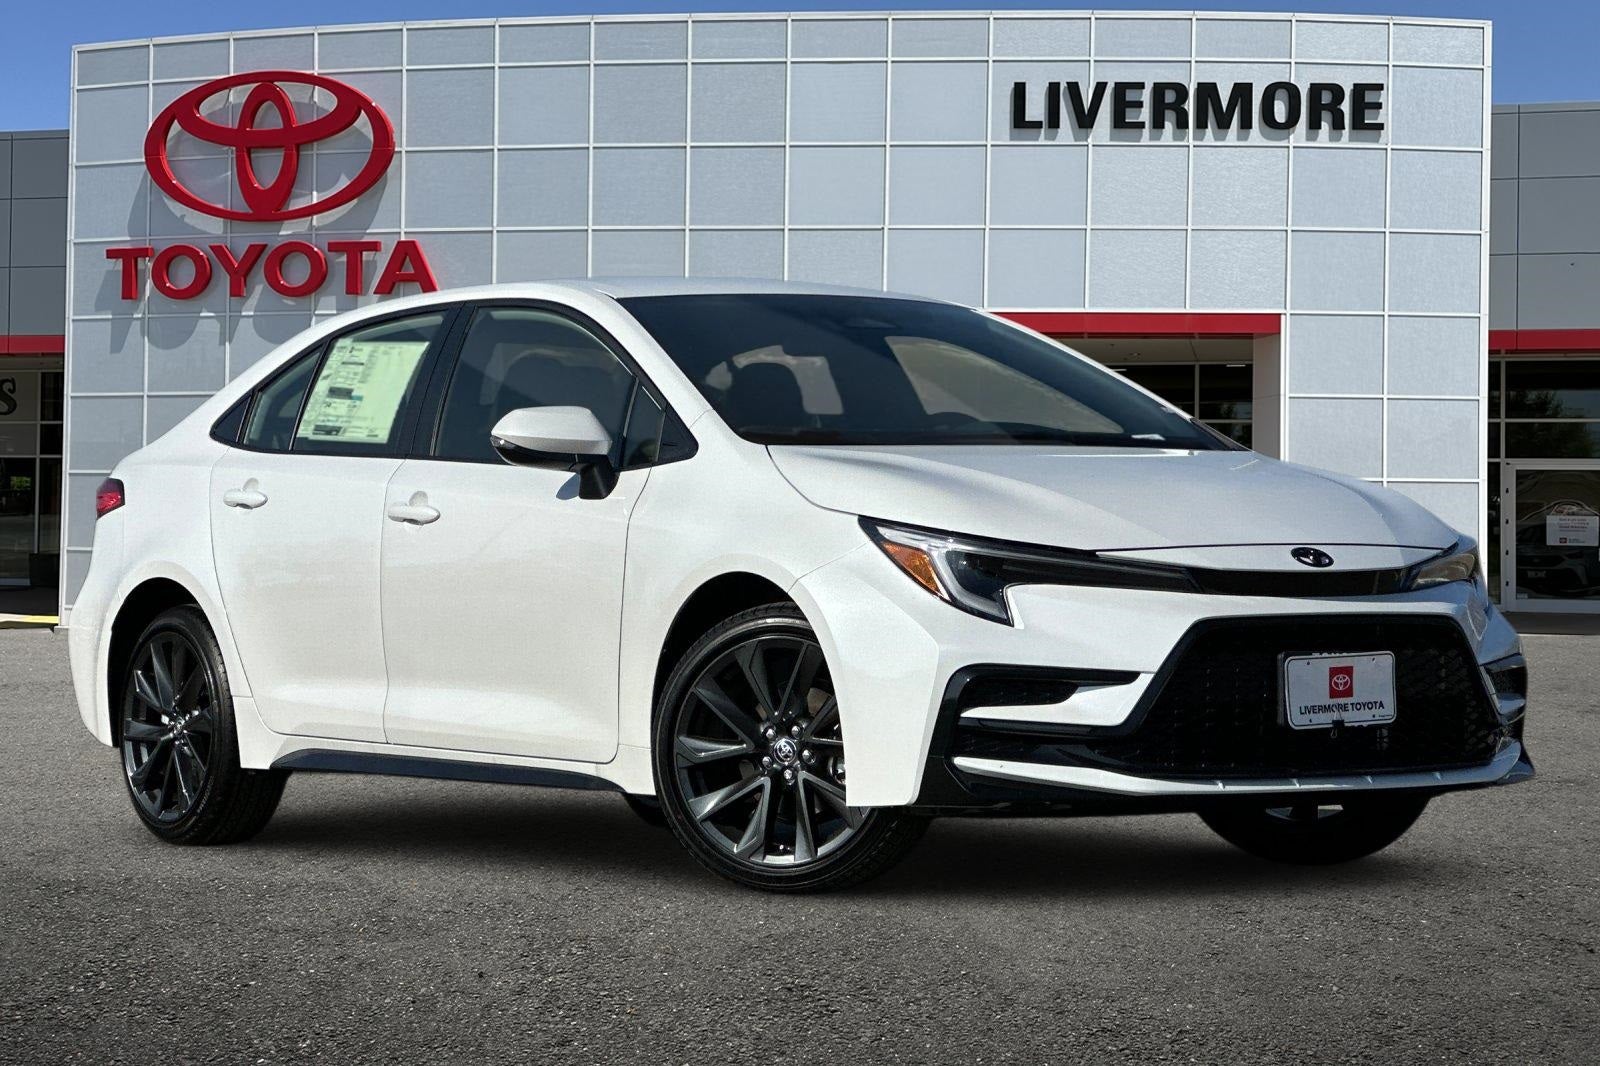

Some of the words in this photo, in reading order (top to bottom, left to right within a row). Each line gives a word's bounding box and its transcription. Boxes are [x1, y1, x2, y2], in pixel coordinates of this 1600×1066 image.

[1013, 81, 1384, 131] LIVERMORE
[106, 239, 439, 300] TOYOTA
[1300, 702, 1349, 715] LIVERMORE
[1351, 700, 1385, 711] TOYOTA
